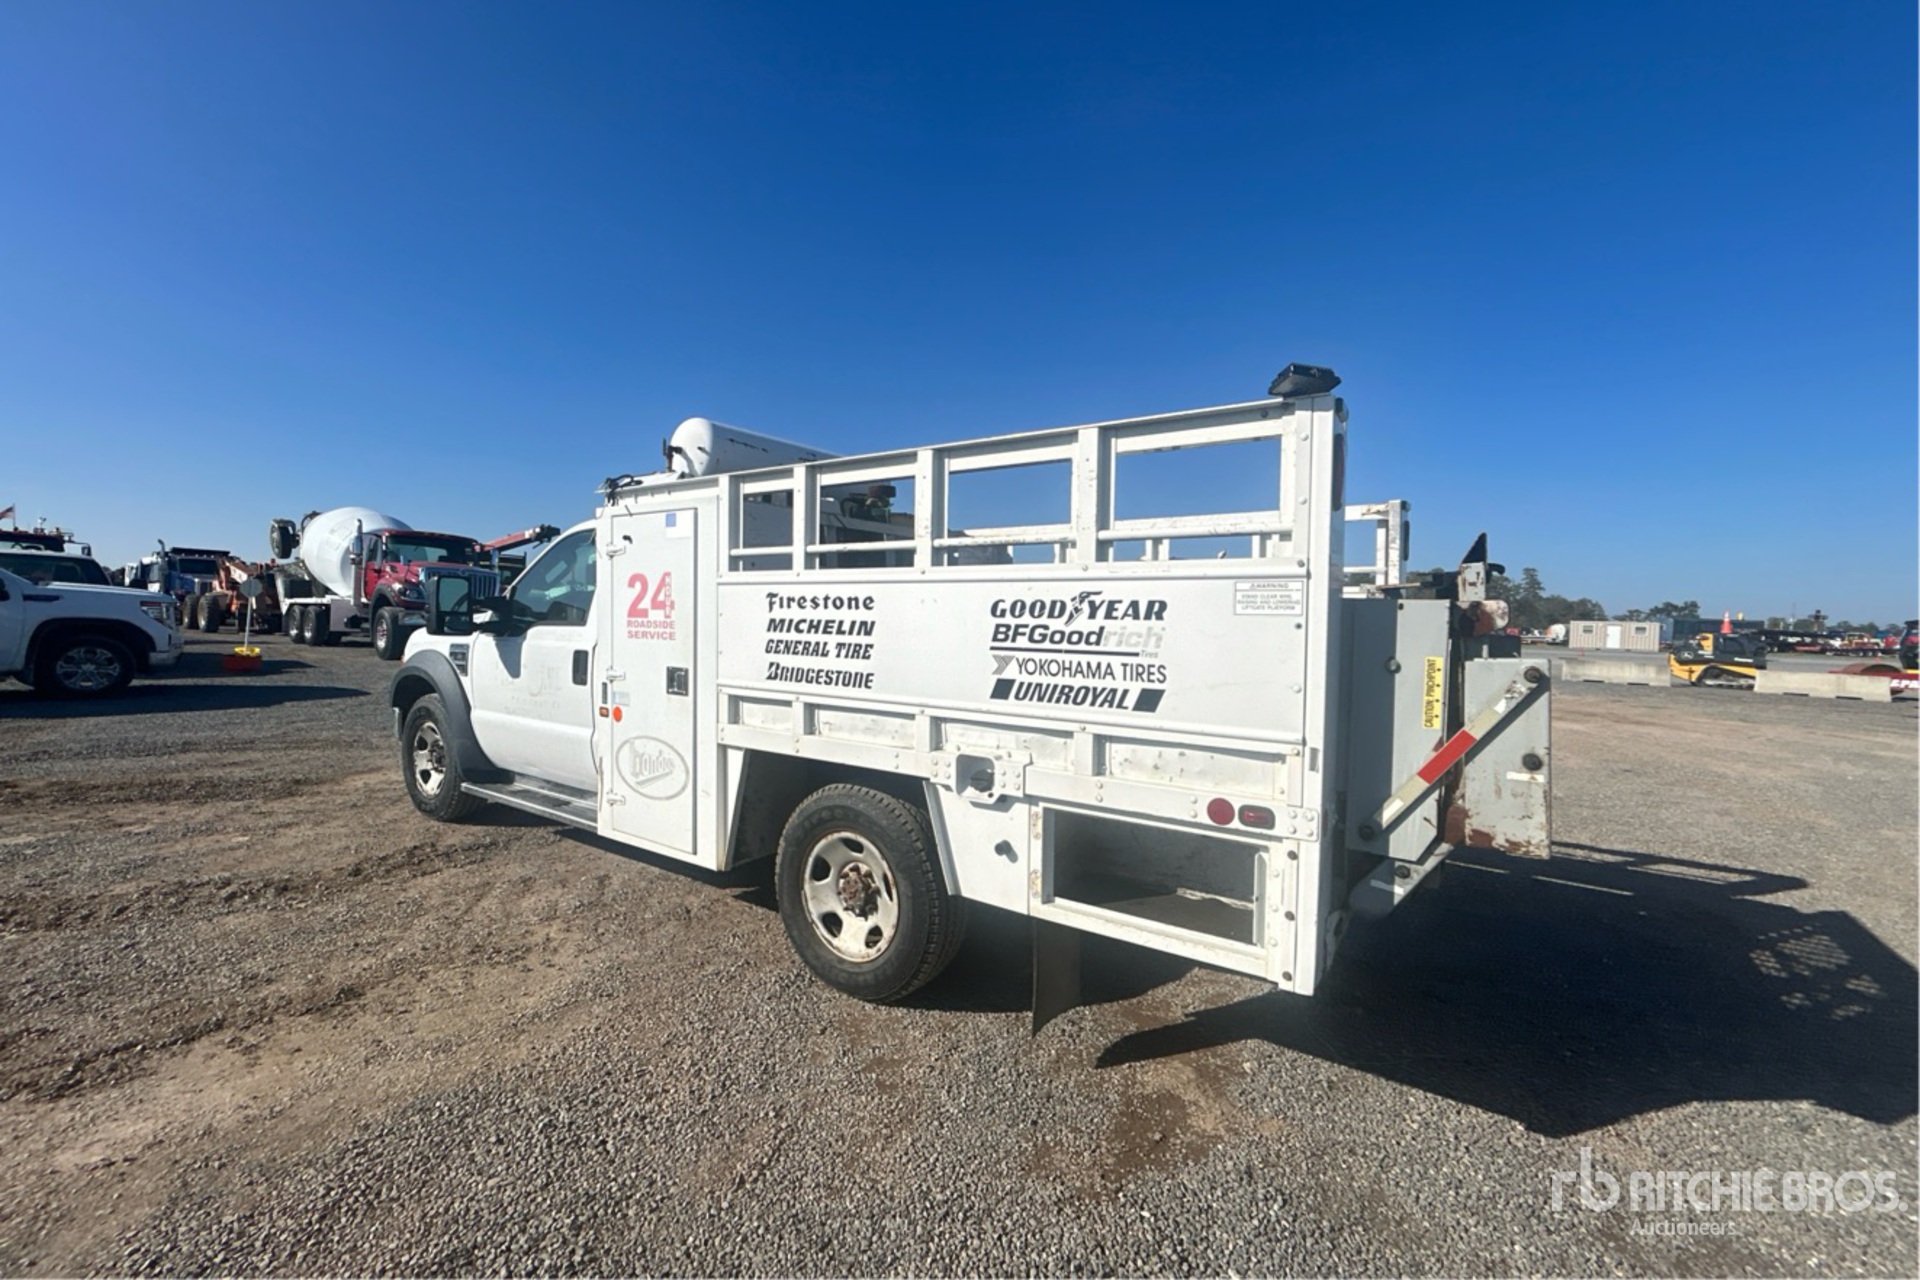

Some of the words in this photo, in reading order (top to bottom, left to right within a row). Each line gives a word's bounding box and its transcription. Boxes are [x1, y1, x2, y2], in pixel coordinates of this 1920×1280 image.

[627, 571, 675, 619] 24
[765, 592, 875, 613] Firestone
[627, 619, 676, 630] ROADSIDE
[627, 630, 676, 641] SERVICE
[766, 618, 876, 637] MICHELIN
[991, 623, 1164, 650] BFGoodrich
[765, 638, 831, 658] GENERAL
[835, 642, 874, 660] TIRE
[1015, 657, 1116, 681] YOKOHAMA
[1120, 662, 1167, 684] TIRES
[1013, 681, 1130, 710] UNIROYAL
